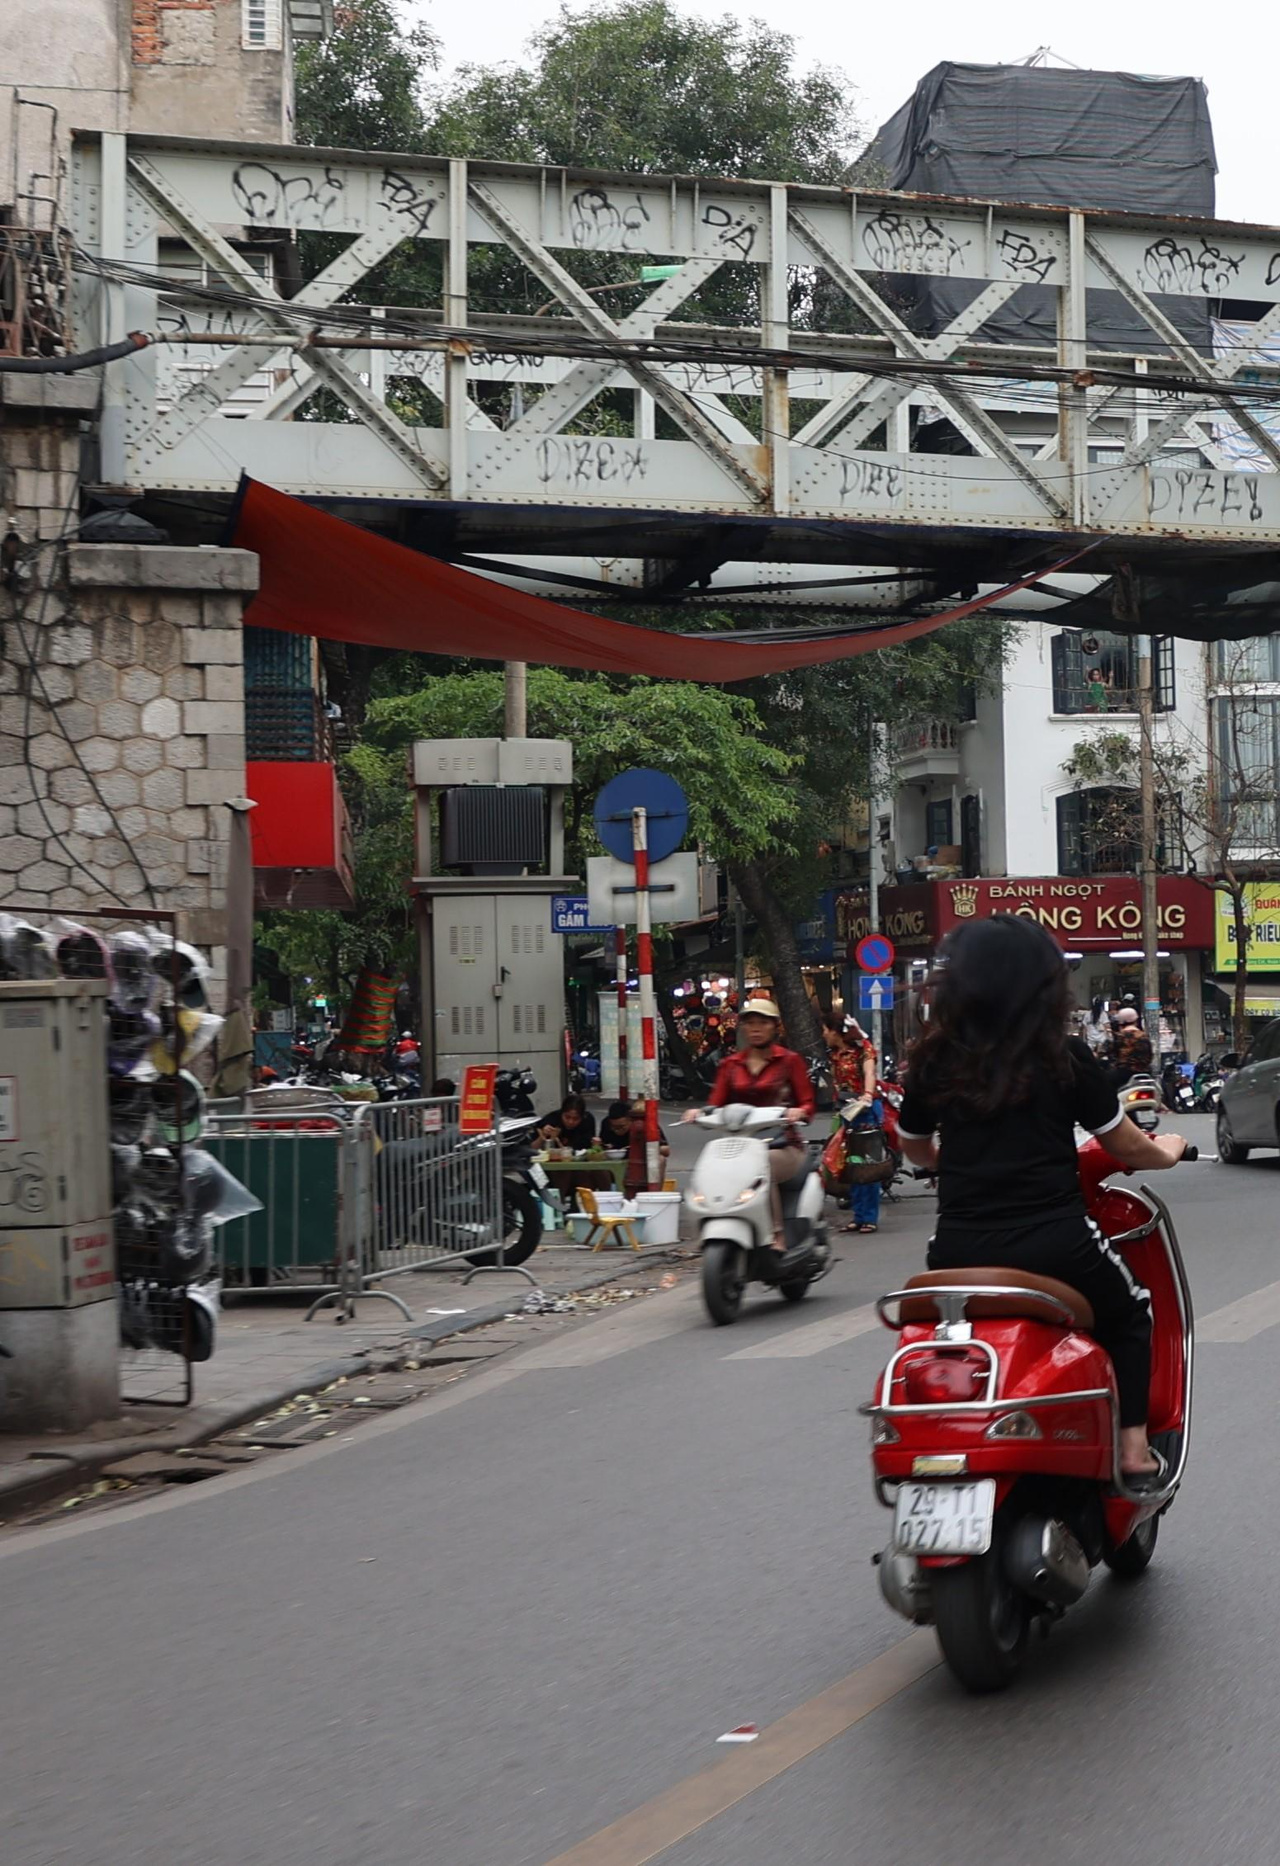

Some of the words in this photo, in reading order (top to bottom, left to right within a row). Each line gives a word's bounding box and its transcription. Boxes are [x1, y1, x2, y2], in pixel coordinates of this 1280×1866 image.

[990, 882, 1044, 898] BÁNH
[1050, 884, 1105, 900] NGỌT
[991, 899, 1082, 930] ỒNG
[910, 1485, 977, 1515] 29-T1
